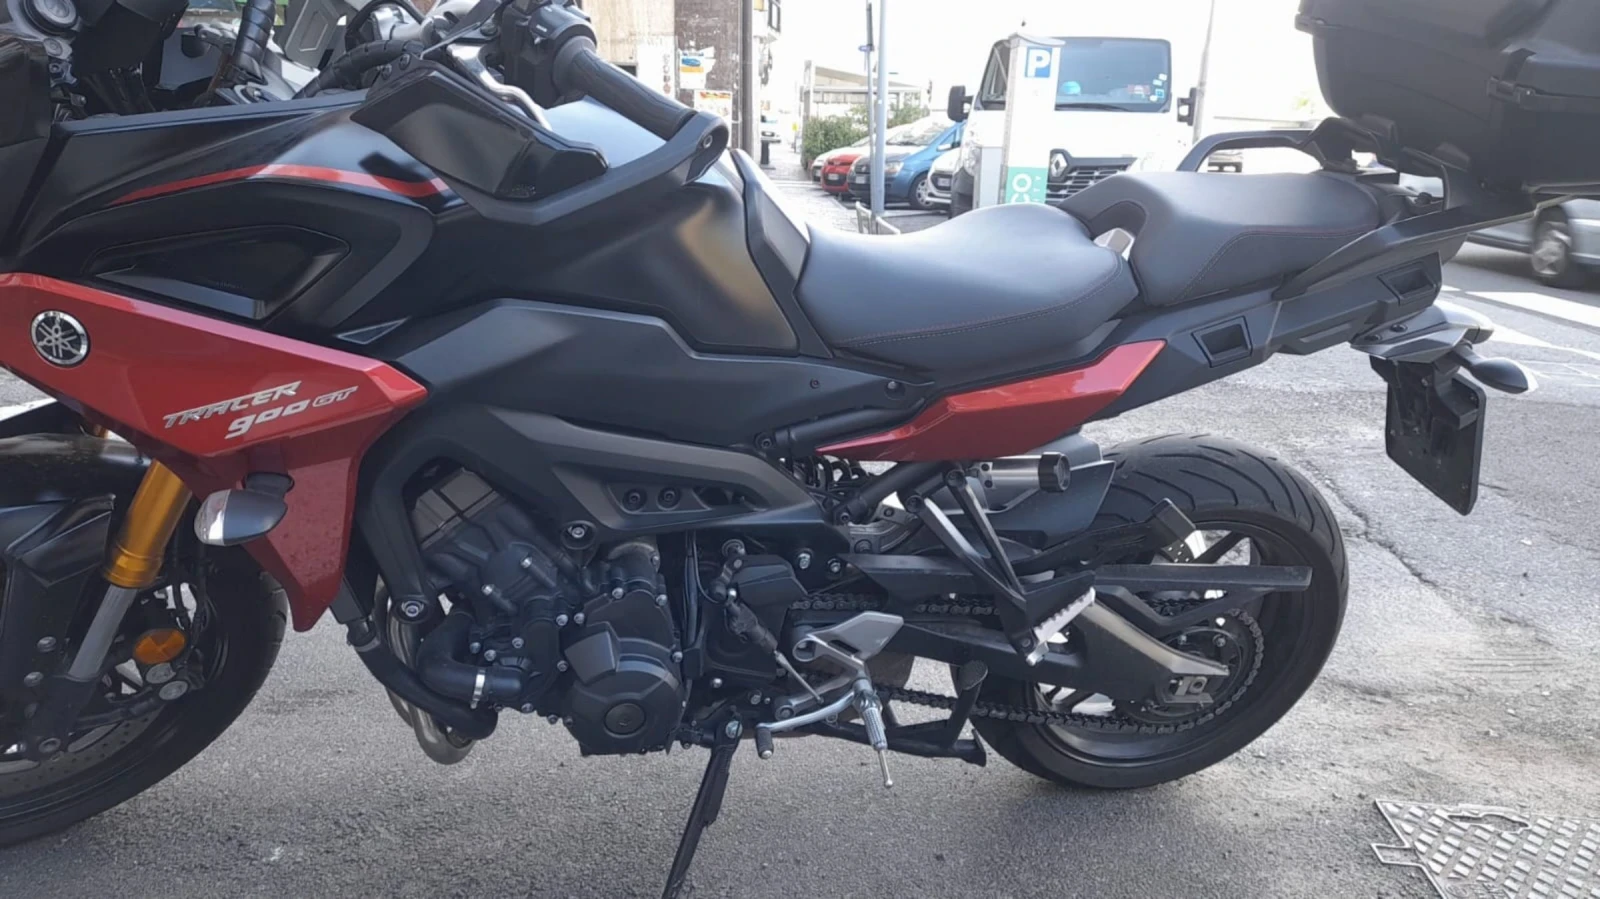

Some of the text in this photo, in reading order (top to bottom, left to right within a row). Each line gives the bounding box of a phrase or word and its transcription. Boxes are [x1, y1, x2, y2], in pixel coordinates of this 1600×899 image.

[1027, 49, 1051, 78] P
[163, 380, 302, 429] TRACER
[224, 386, 359, 440] 900 GT
